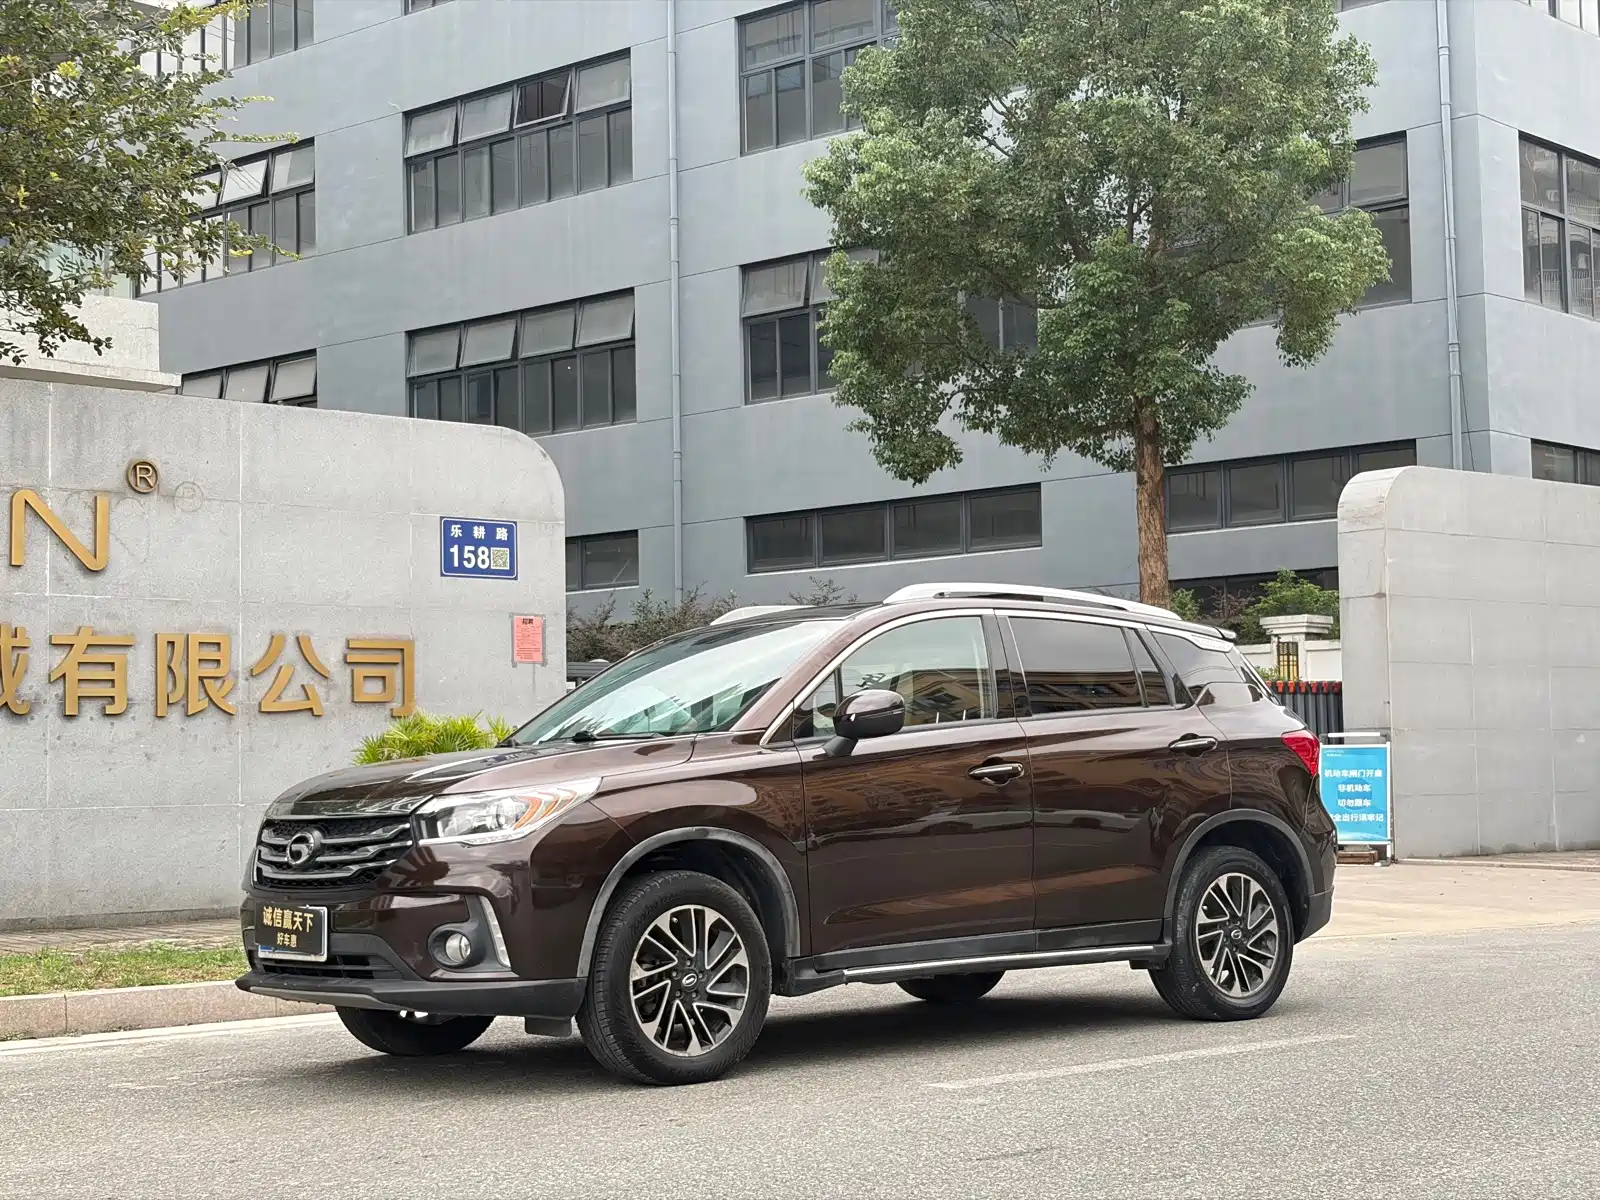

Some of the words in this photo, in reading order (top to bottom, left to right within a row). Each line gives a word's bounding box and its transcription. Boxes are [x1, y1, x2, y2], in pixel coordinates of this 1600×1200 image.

[450, 524, 509, 541] 乐耕路
[449, 544, 490, 569] 158
[1338, 784, 1371, 792] 非机动车
[1338, 799, 1371, 807] 切勿跟车
[1331, 813, 1383, 821] 全出行须牢记
[263, 906, 314, 932] 诚信赢天下
[277, 932, 297, 947] 好车惠
